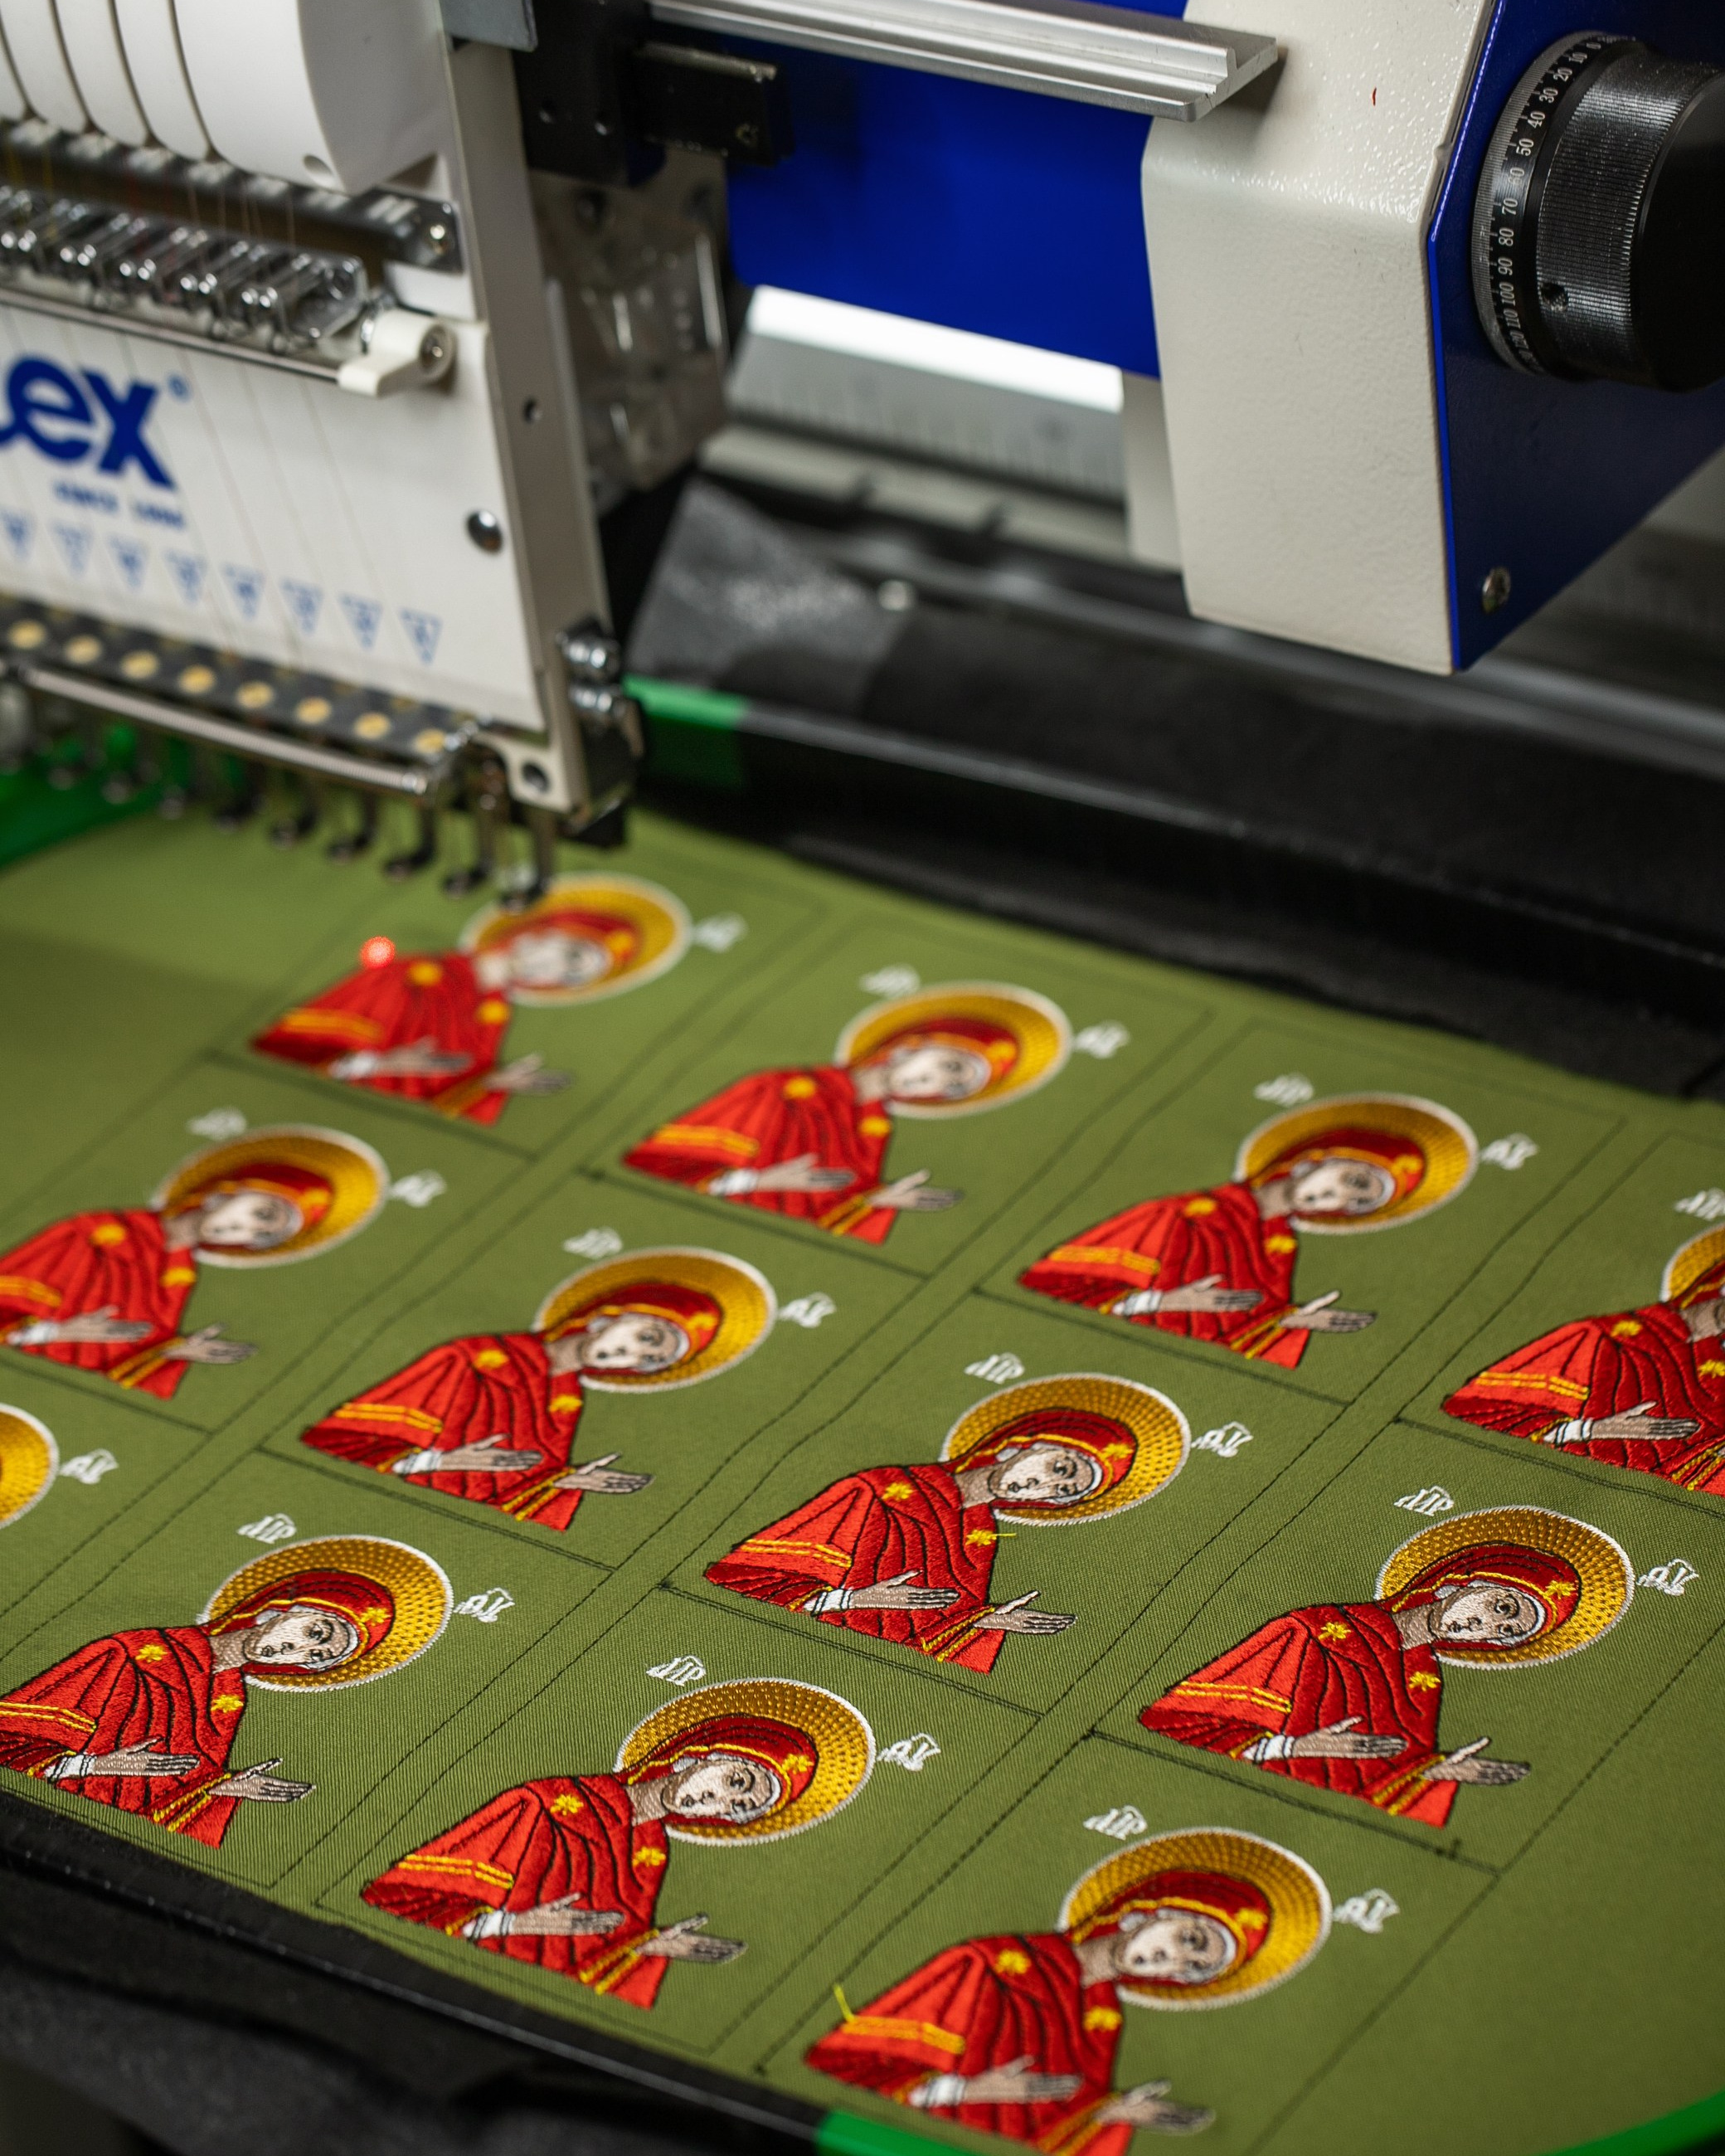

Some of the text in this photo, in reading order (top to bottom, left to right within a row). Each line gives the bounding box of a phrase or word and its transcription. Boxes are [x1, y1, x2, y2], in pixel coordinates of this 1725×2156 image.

[1568, 51, 1588, 64] 10
[1552, 67, 1572, 82] 20
[1539, 87, 1558, 104] 30
[1528, 110, 1546, 129] 40
[1516, 138, 1534, 156] 50
[1507, 167, 1525, 184] 60
[1501, 197, 1518, 216] 70
[1498, 227, 1514, 246] 80
[1498, 256, 1513, 275] 90
[1499, 282, 1516, 306] 100
[1504, 309, 1521, 329] 110
